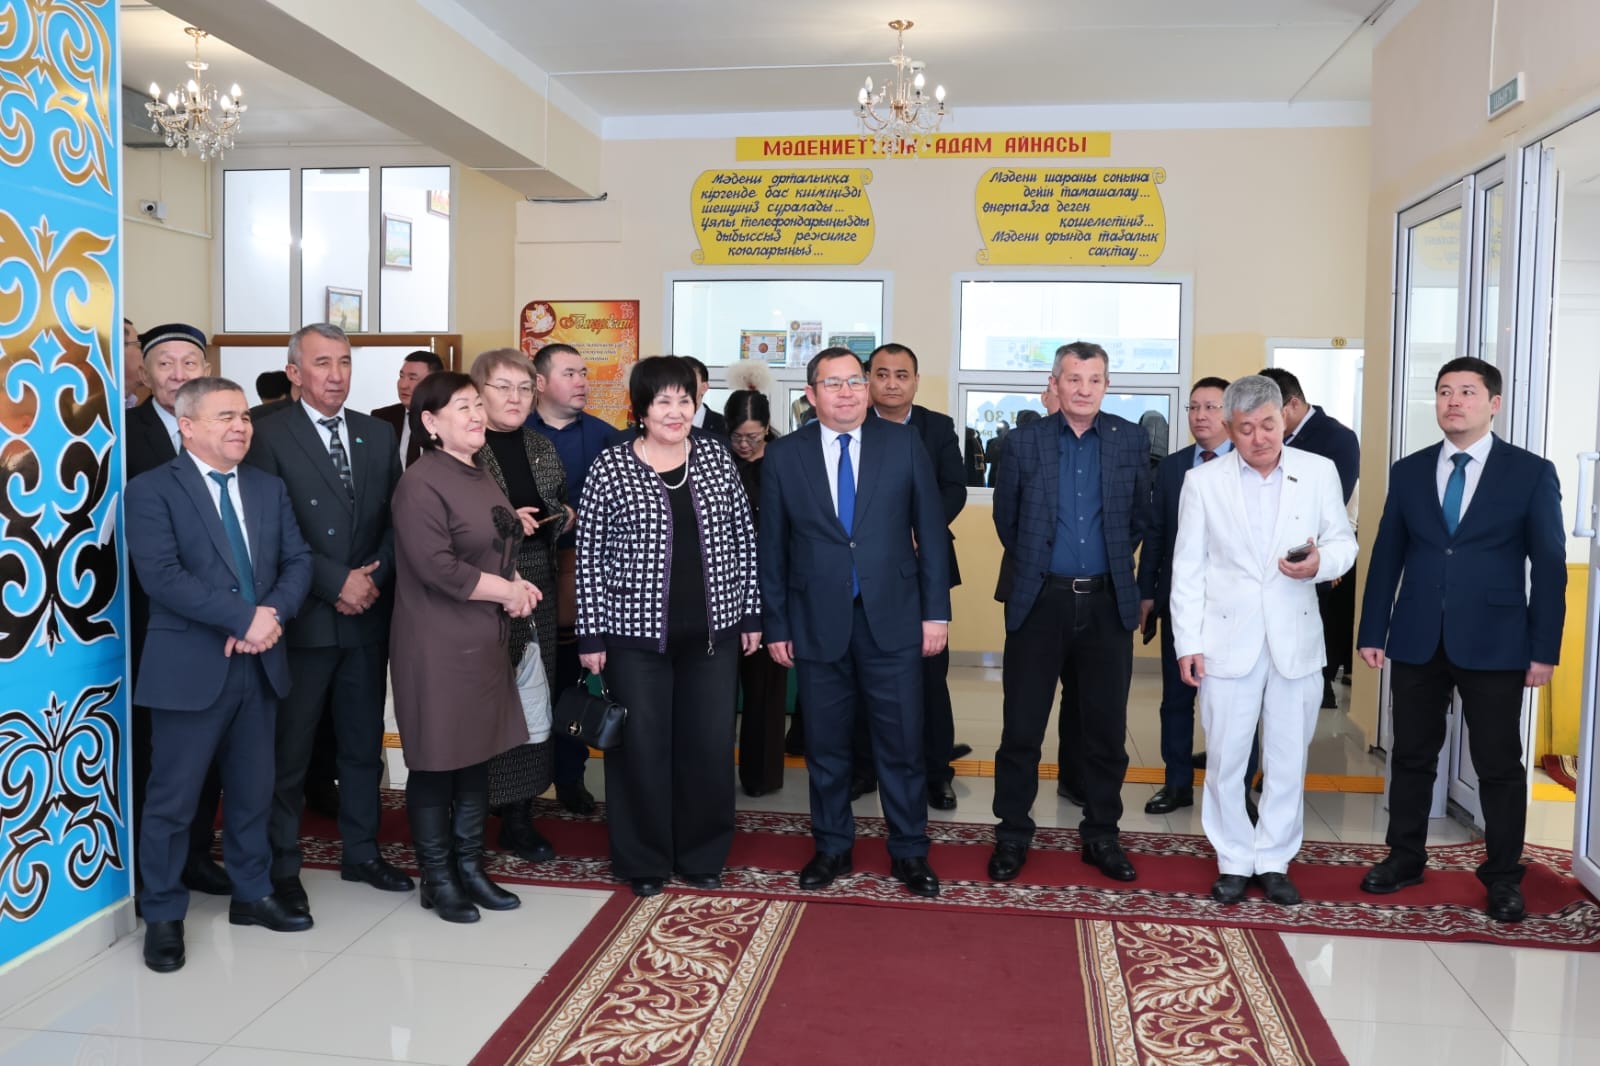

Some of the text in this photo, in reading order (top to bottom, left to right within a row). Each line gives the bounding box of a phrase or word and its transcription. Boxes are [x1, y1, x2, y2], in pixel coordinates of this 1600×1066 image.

[935, 137, 992, 154] АДАМ
[1005, 135, 1087, 153] АЙНАСЫ
[1044, 173, 1097, 186] шараны
[764, 186, 789, 198] бас
[1023, 185, 1054, 198] дейін
[1057, 200, 1091, 212] деген
[793, 232, 857, 244] режимге
[991, 231, 1039, 243] Мәдени
[1045, 230, 1092, 245] орында
[1335, 338, 1345, 346] 10
